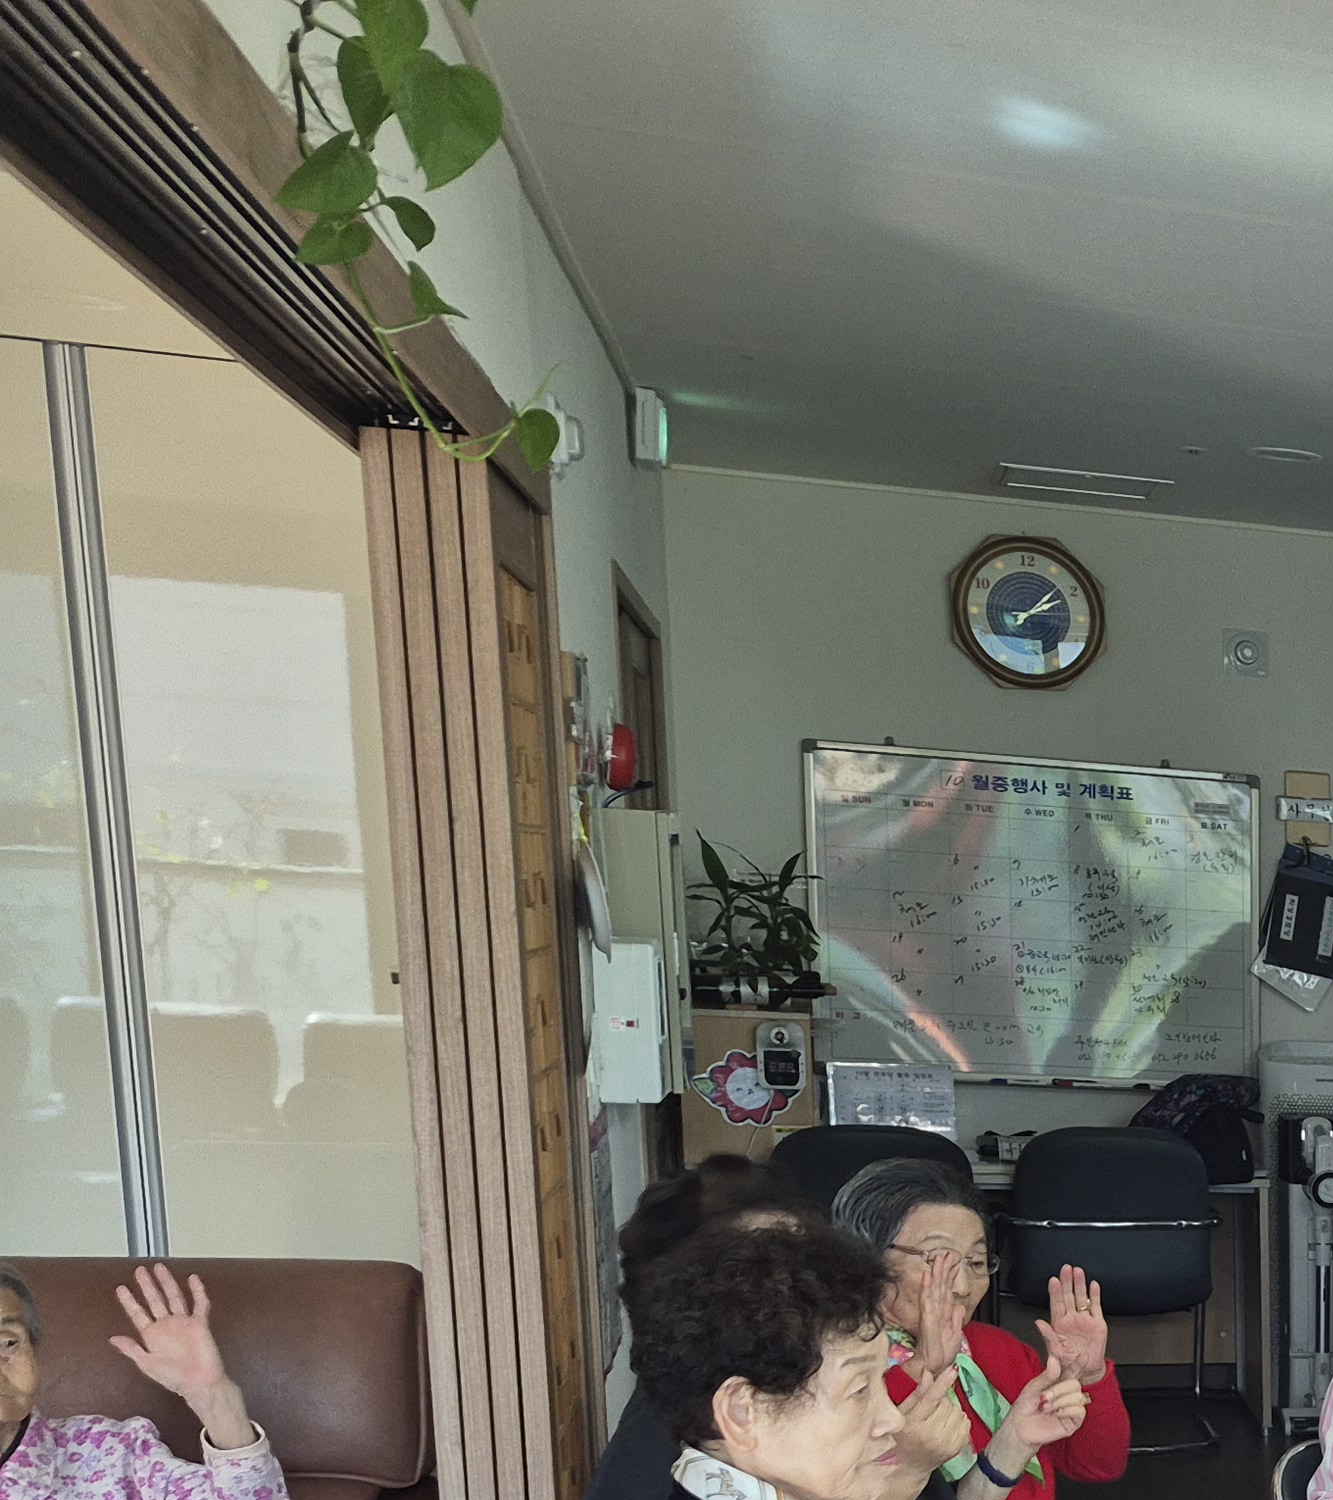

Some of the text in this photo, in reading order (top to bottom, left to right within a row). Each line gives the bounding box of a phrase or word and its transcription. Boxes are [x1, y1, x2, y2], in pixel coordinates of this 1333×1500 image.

[1019, 555, 1035, 567] 12
[976, 578, 990, 589] 10
[1070, 586, 1078, 597] 2
[972, 774, 1048, 795] 월중행사
[1055, 781, 1071, 797] 및
[1079, 783, 1134, 801] 계획표
[913, 799, 934, 808] MON
[975, 804, 994, 813] TUE
[1035, 809, 1055, 817] WED
[1156, 818, 1170, 826] FRI
[1211, 822, 1228, 830] SAT
